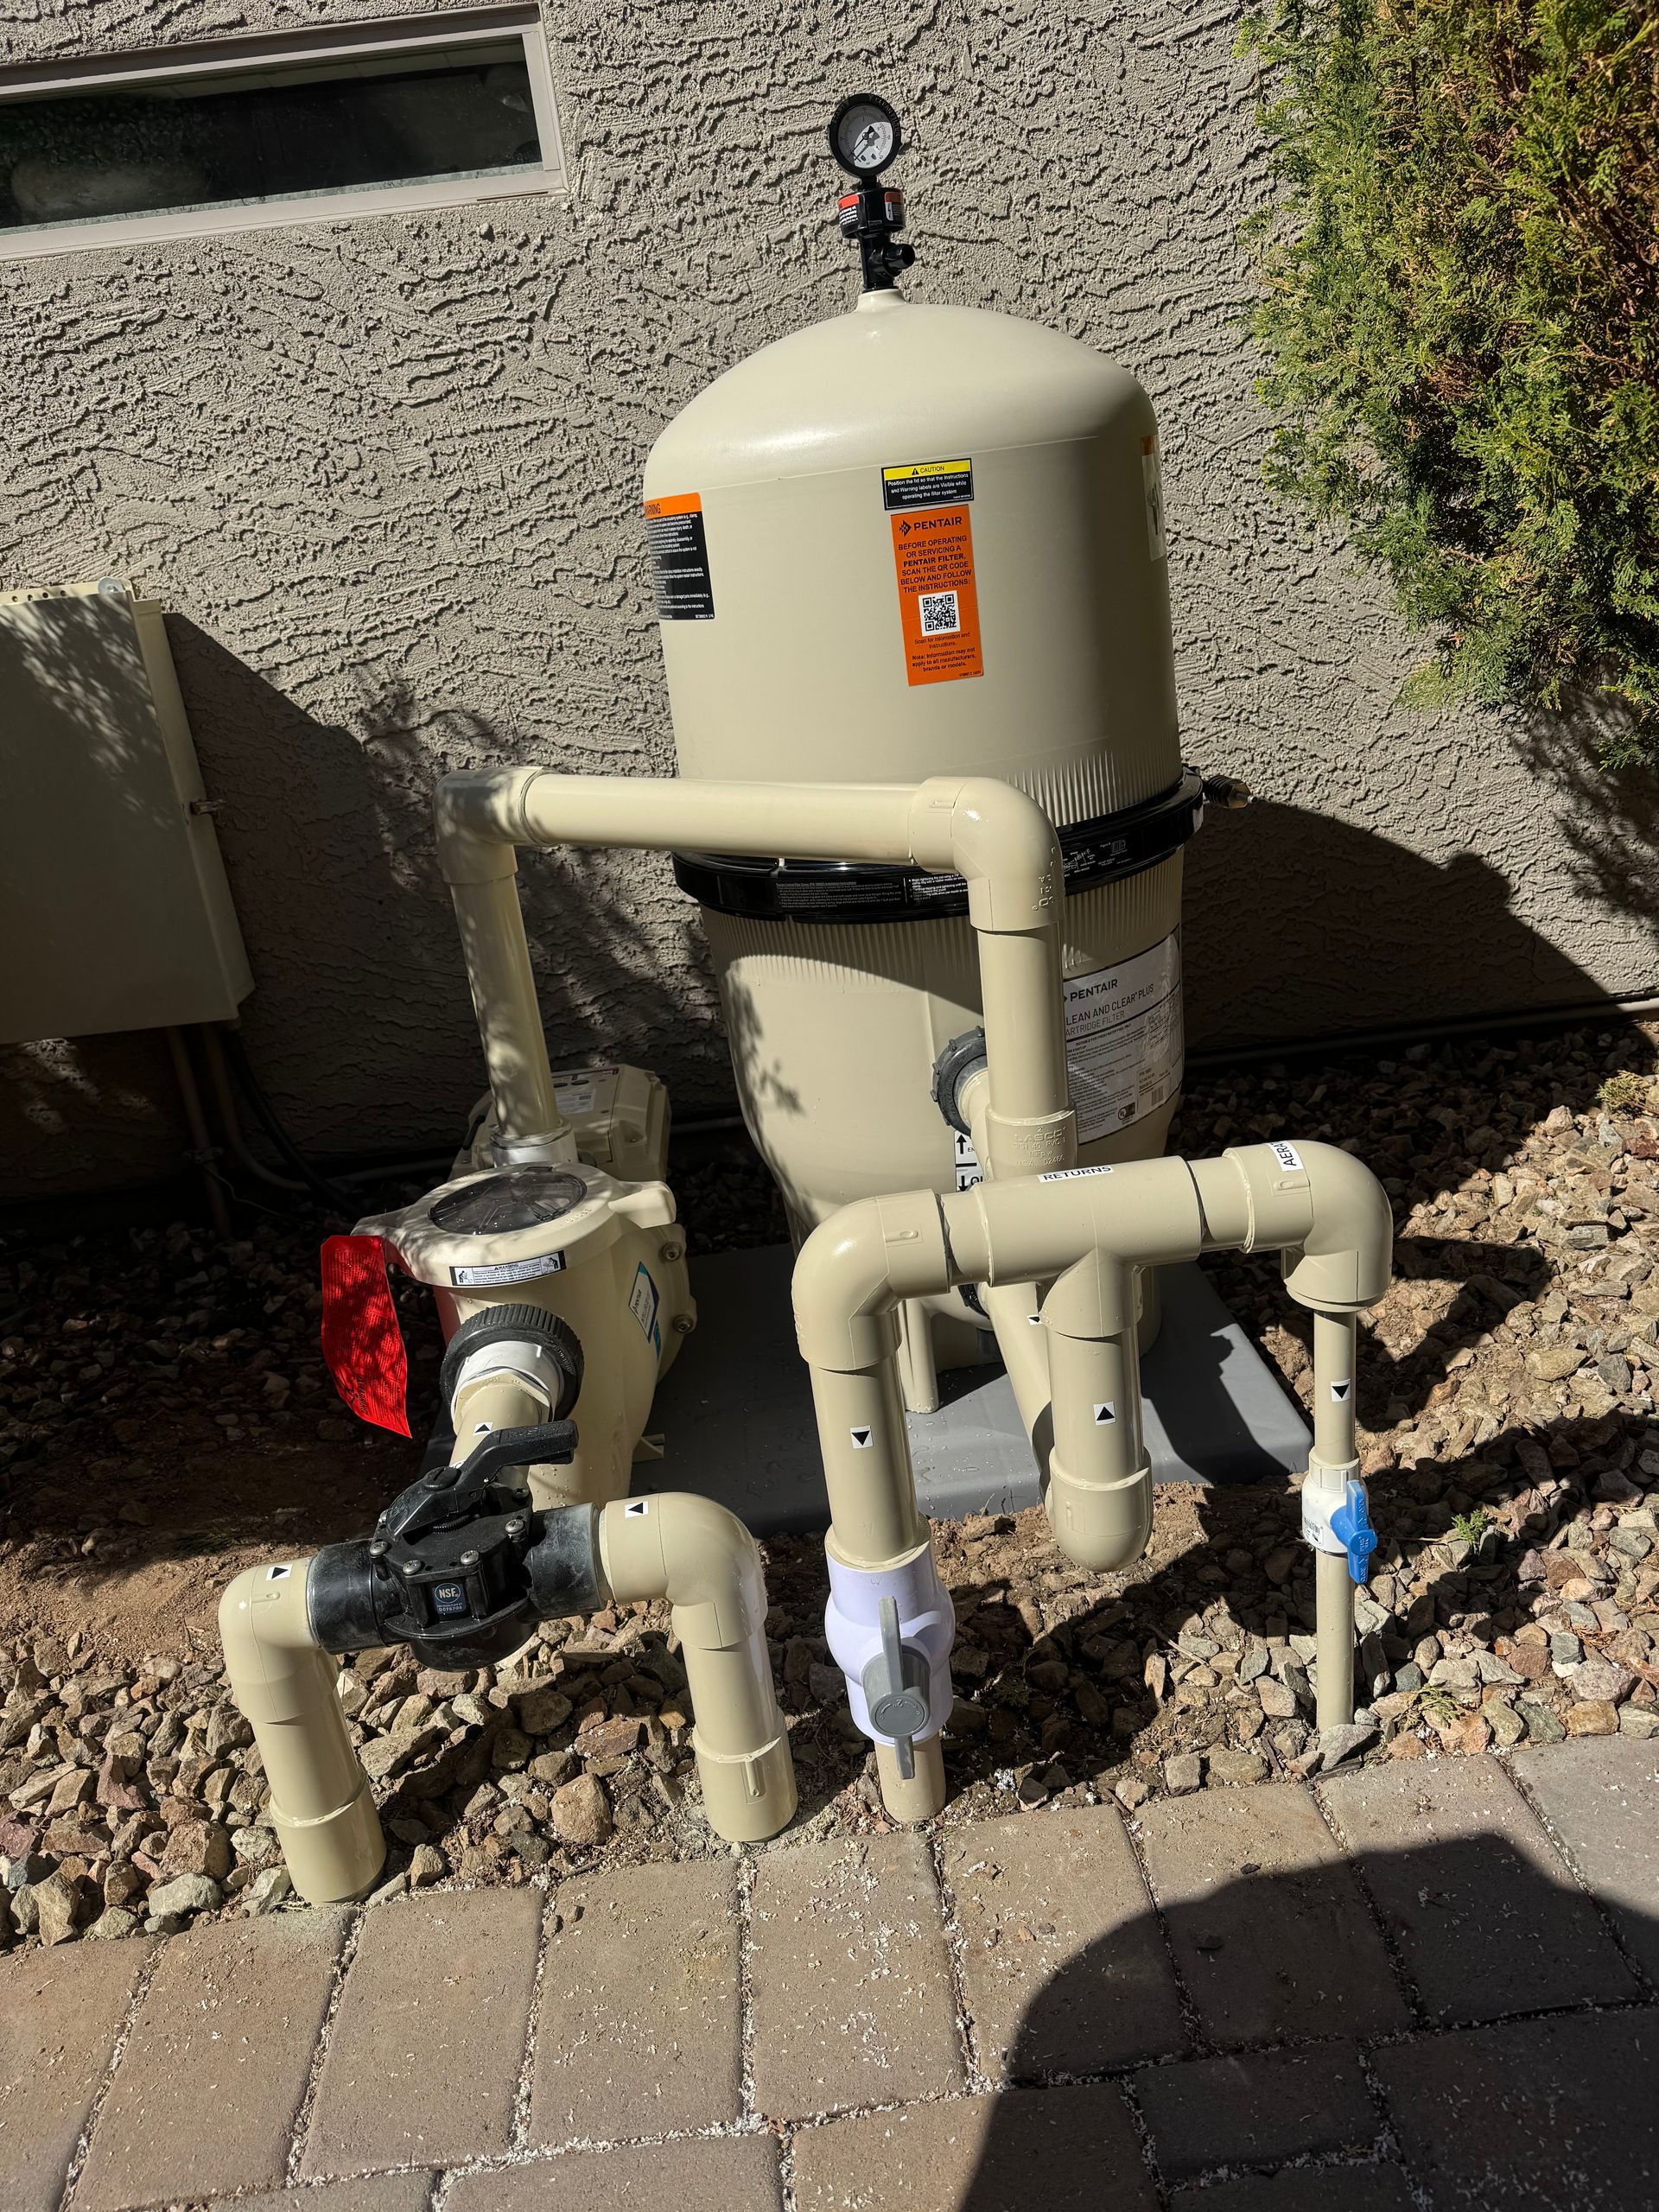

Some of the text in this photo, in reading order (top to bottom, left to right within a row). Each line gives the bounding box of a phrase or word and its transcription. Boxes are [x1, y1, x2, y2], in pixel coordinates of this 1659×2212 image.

[914, 516, 962, 531] PENTAIR
[898, 535, 967, 550] BEFORE OPERATING
[918, 546, 955, 556] SERVICING
[903, 553, 966, 567] PENTAIR FILTER,
[902, 568, 921, 576] SCAN
[949, 561, 969, 569] CODE
[901, 576, 925, 585] BELOW
[943, 570, 971, 579] FOLLOW
[919, 579, 970, 591] INSTRUCTIONS:
[1070, 978, 1118, 1002] PENTAIR
[1065, 1010, 1091, 1026] LEAN
[1092, 1004, 1110, 1019] AND
[1138, 983, 1154, 999] PLUS
[1066, 1010, 1125, 1036] ARTRIDGE FILTER
[1015, 1129, 1062, 1142] LASCO
[1044, 1166, 1112, 1180] RETURNS
[439, 1587, 456, 1599] NSF
